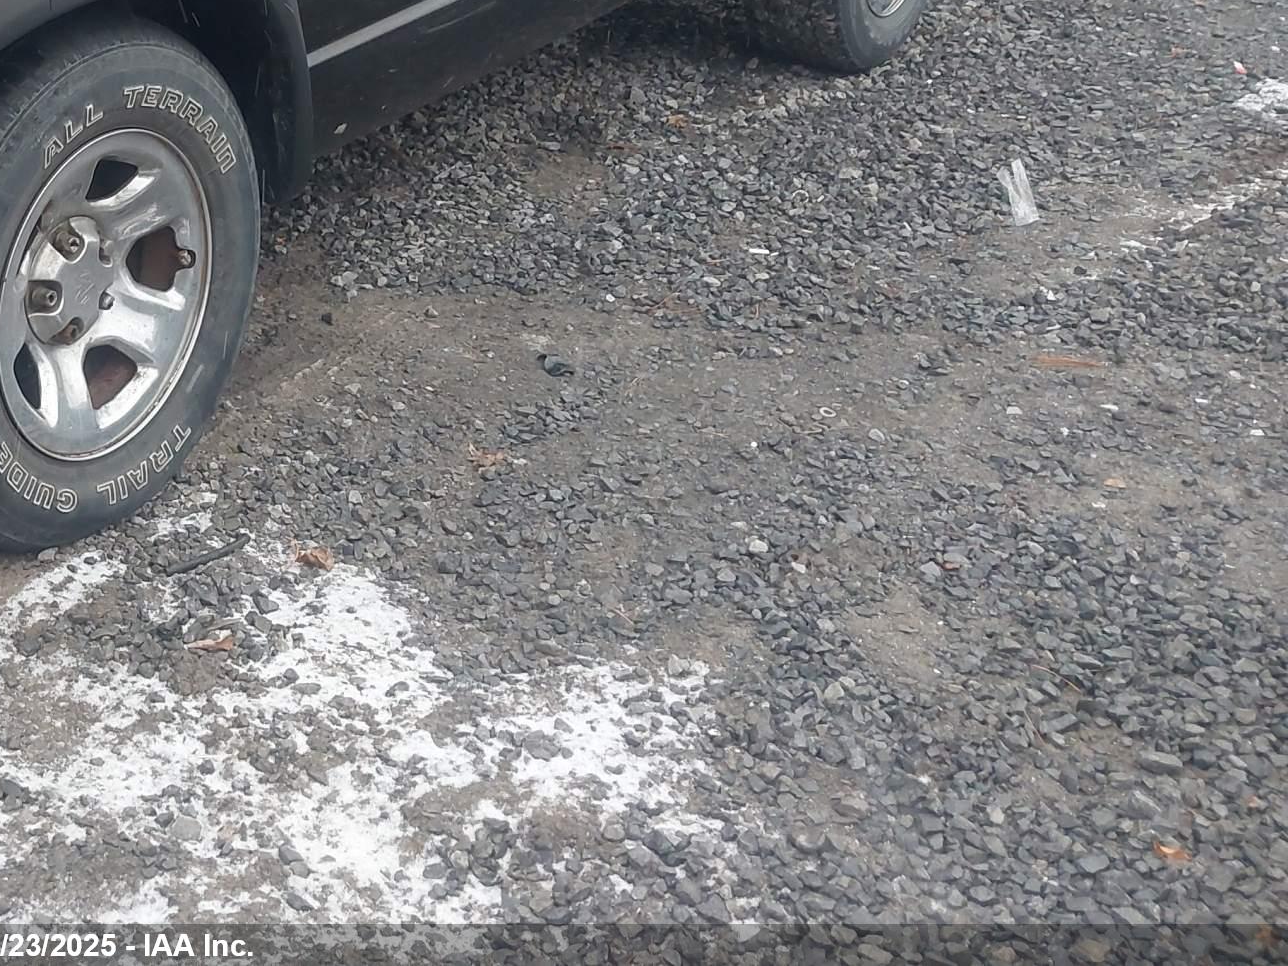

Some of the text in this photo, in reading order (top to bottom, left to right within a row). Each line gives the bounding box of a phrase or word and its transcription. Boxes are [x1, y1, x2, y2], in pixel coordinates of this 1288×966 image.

[44, 85, 237, 175] ALL TERRAIN
[96, 424, 192, 505] TRAIL
